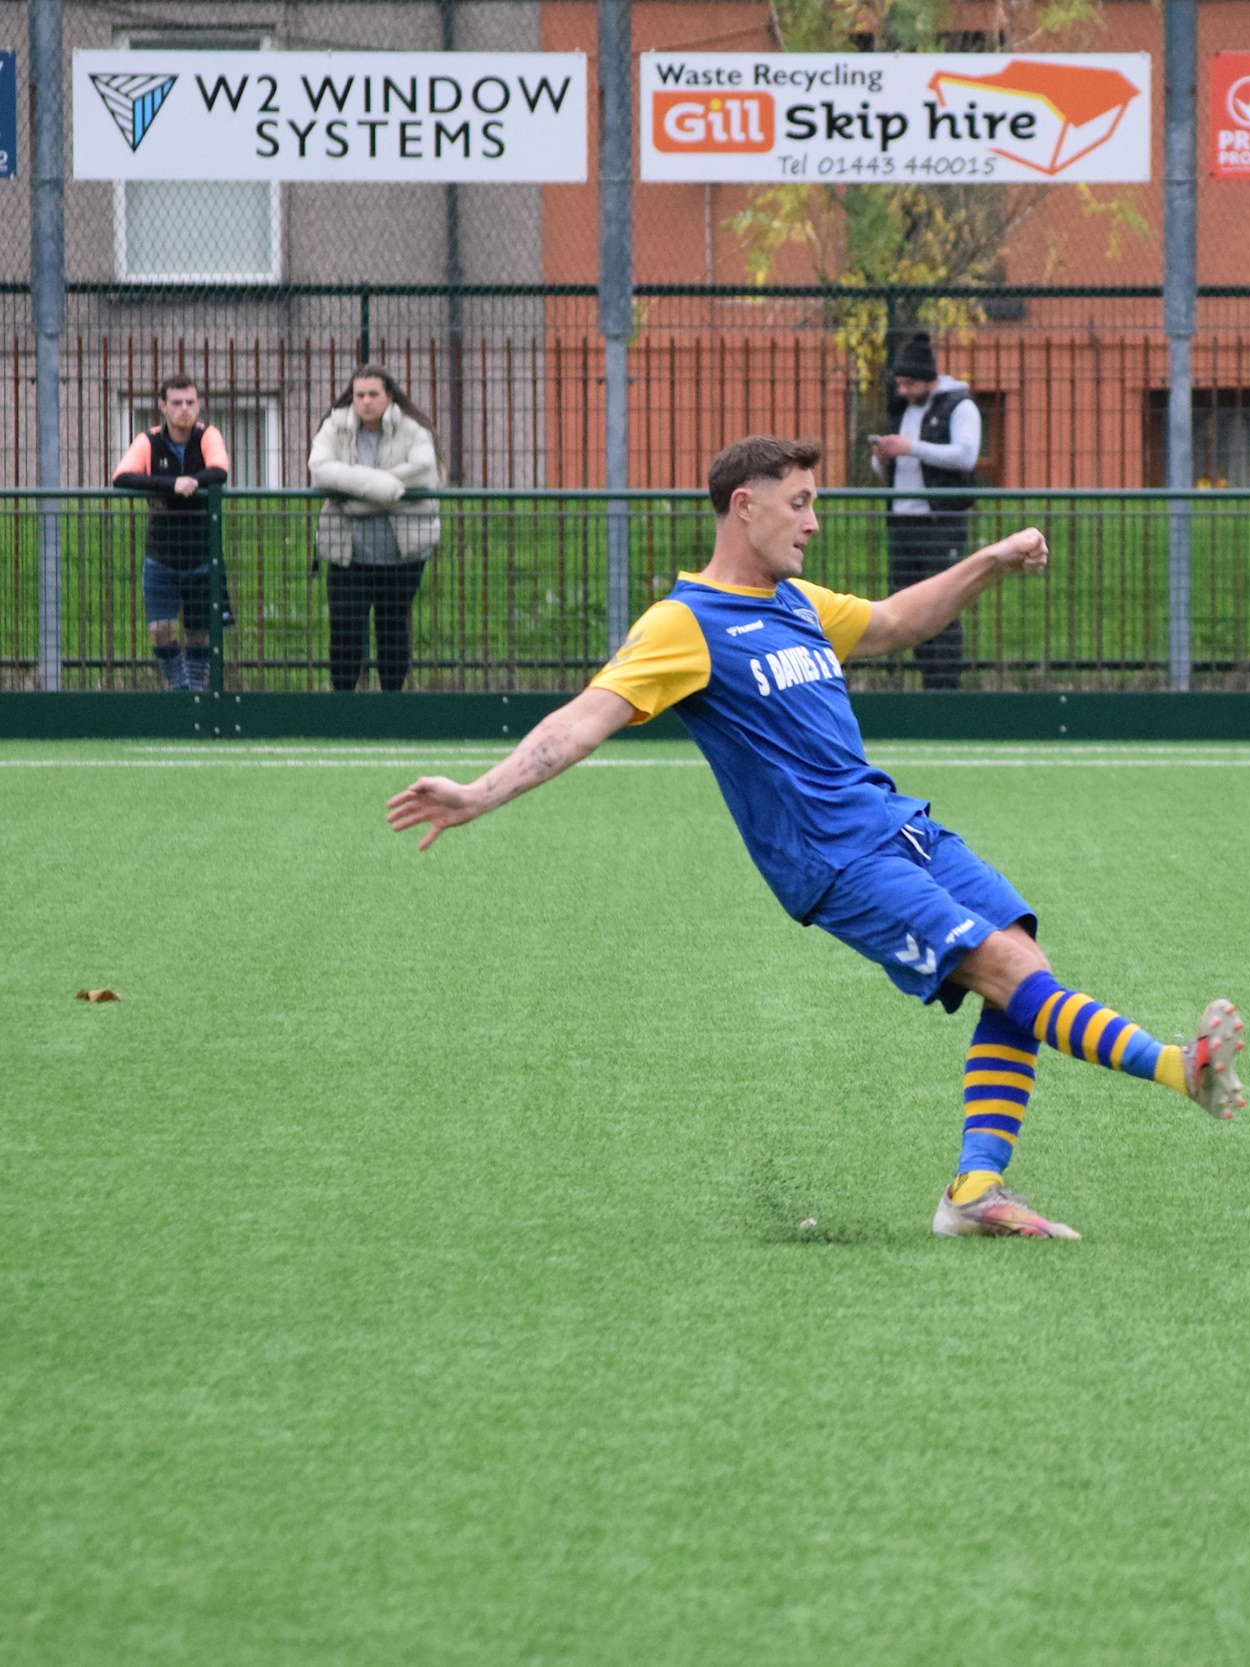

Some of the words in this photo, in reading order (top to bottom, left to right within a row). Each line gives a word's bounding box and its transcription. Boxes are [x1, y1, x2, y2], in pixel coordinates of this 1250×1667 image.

[195, 74, 280, 114] W2
[301, 74, 572, 114] WINDOW
[655, 63, 742, 87] Waste
[753, 62, 884, 92] Recycling
[255, 119, 506, 159] SYSTEMS
[663, 98, 766, 143] Gill
[784, 101, 909, 152] Skip
[923, 101, 1037, 141] hire
[777, 154, 807, 175] Tel
[818, 155, 896, 176] 01443
[903, 155, 998, 176] 440015
[749, 658, 771, 697] S
[765, 646, 821, 691] DAVIES
